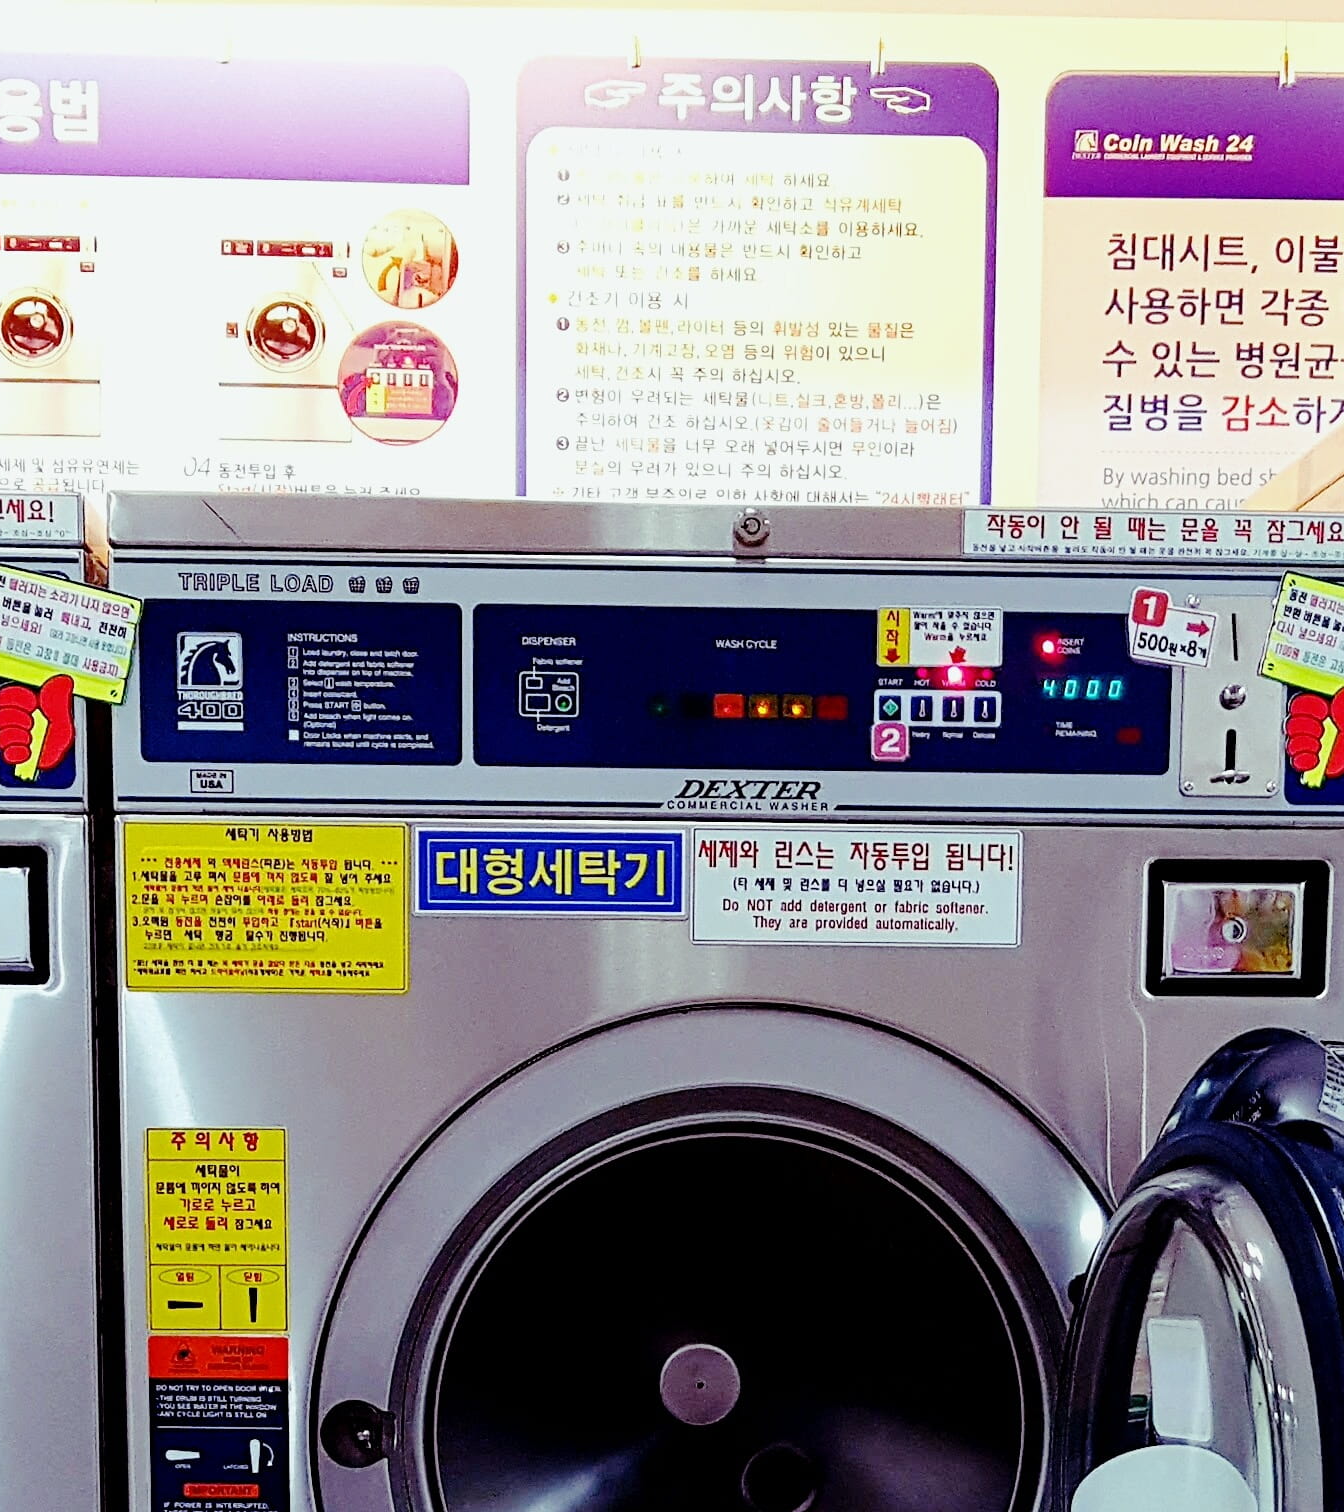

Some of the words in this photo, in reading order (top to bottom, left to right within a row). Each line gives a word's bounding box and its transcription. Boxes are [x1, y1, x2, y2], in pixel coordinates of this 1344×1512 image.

[658, 72, 857, 123] 주의사항
[1103, 132, 1156, 153] Coin
[1160, 132, 1221, 153] Wash
[1225, 133, 1254, 153] 24
[1106, 233, 1258, 275] 침대시트,
[1105, 287, 1244, 327] 사용하면
[1260, 289, 1329, 328] 각종
[1102, 340, 1137, 379] 수
[1152, 342, 1220, 379] 있는
[1103, 393, 1206, 432] 질병을
[1102, 468, 1127, 488] By
[1130, 467, 1210, 491] washing
[1217, 468, 1253, 487] bed
[1102, 494, 1161, 510] which
[1166, 498, 1199, 510] can
[987, 514, 1045, 540] 작동이
[1061, 516, 1079, 539] 안
[1094, 517, 1112, 540] 될
[1128, 517, 1166, 541] 때는
[1181, 518, 1219, 542] 문을
[1234, 519, 1252, 543] 꼭
[179, 572, 261, 594] TRIPLE
[270, 573, 335, 595] LOAD
[1143, 597, 1156, 619] 1
[287, 633, 358, 643] INSTRUCTIONS
[522, 637, 576, 646] DISPENSER
[715, 639, 744, 649] WASH
[746, 640, 777, 649] CYCLE
[1042, 676, 1124, 698] 4000
[178, 702, 243, 719] 400
[880, 728, 901, 753] 2
[200, 780, 223, 789] USA
[675, 780, 821, 800] DEXTER
[667, 800, 762, 811] COMMERCIAL
[770, 801, 828, 811] WASHER
[698, 839, 759, 868] 세제와
[775, 841, 834, 869] 린스는
[850, 842, 929, 871] 자동투입
[946, 843, 1014, 872] 됩니다!
[435, 849, 667, 898] 대형세탁기
[723, 899, 739, 911] Do
[747, 899, 772, 912] NOT
[780, 899, 802, 912] add
[810, 899, 867, 915] detergent
[874, 903, 887, 913] or
[894, 900, 929, 914] fabric
[936, 901, 989, 915] softener.
[753, 915, 781, 931] They
[789, 919, 808, 929] are
[815, 916, 868, 932] provided
[875, 917, 958, 933] automatically.
